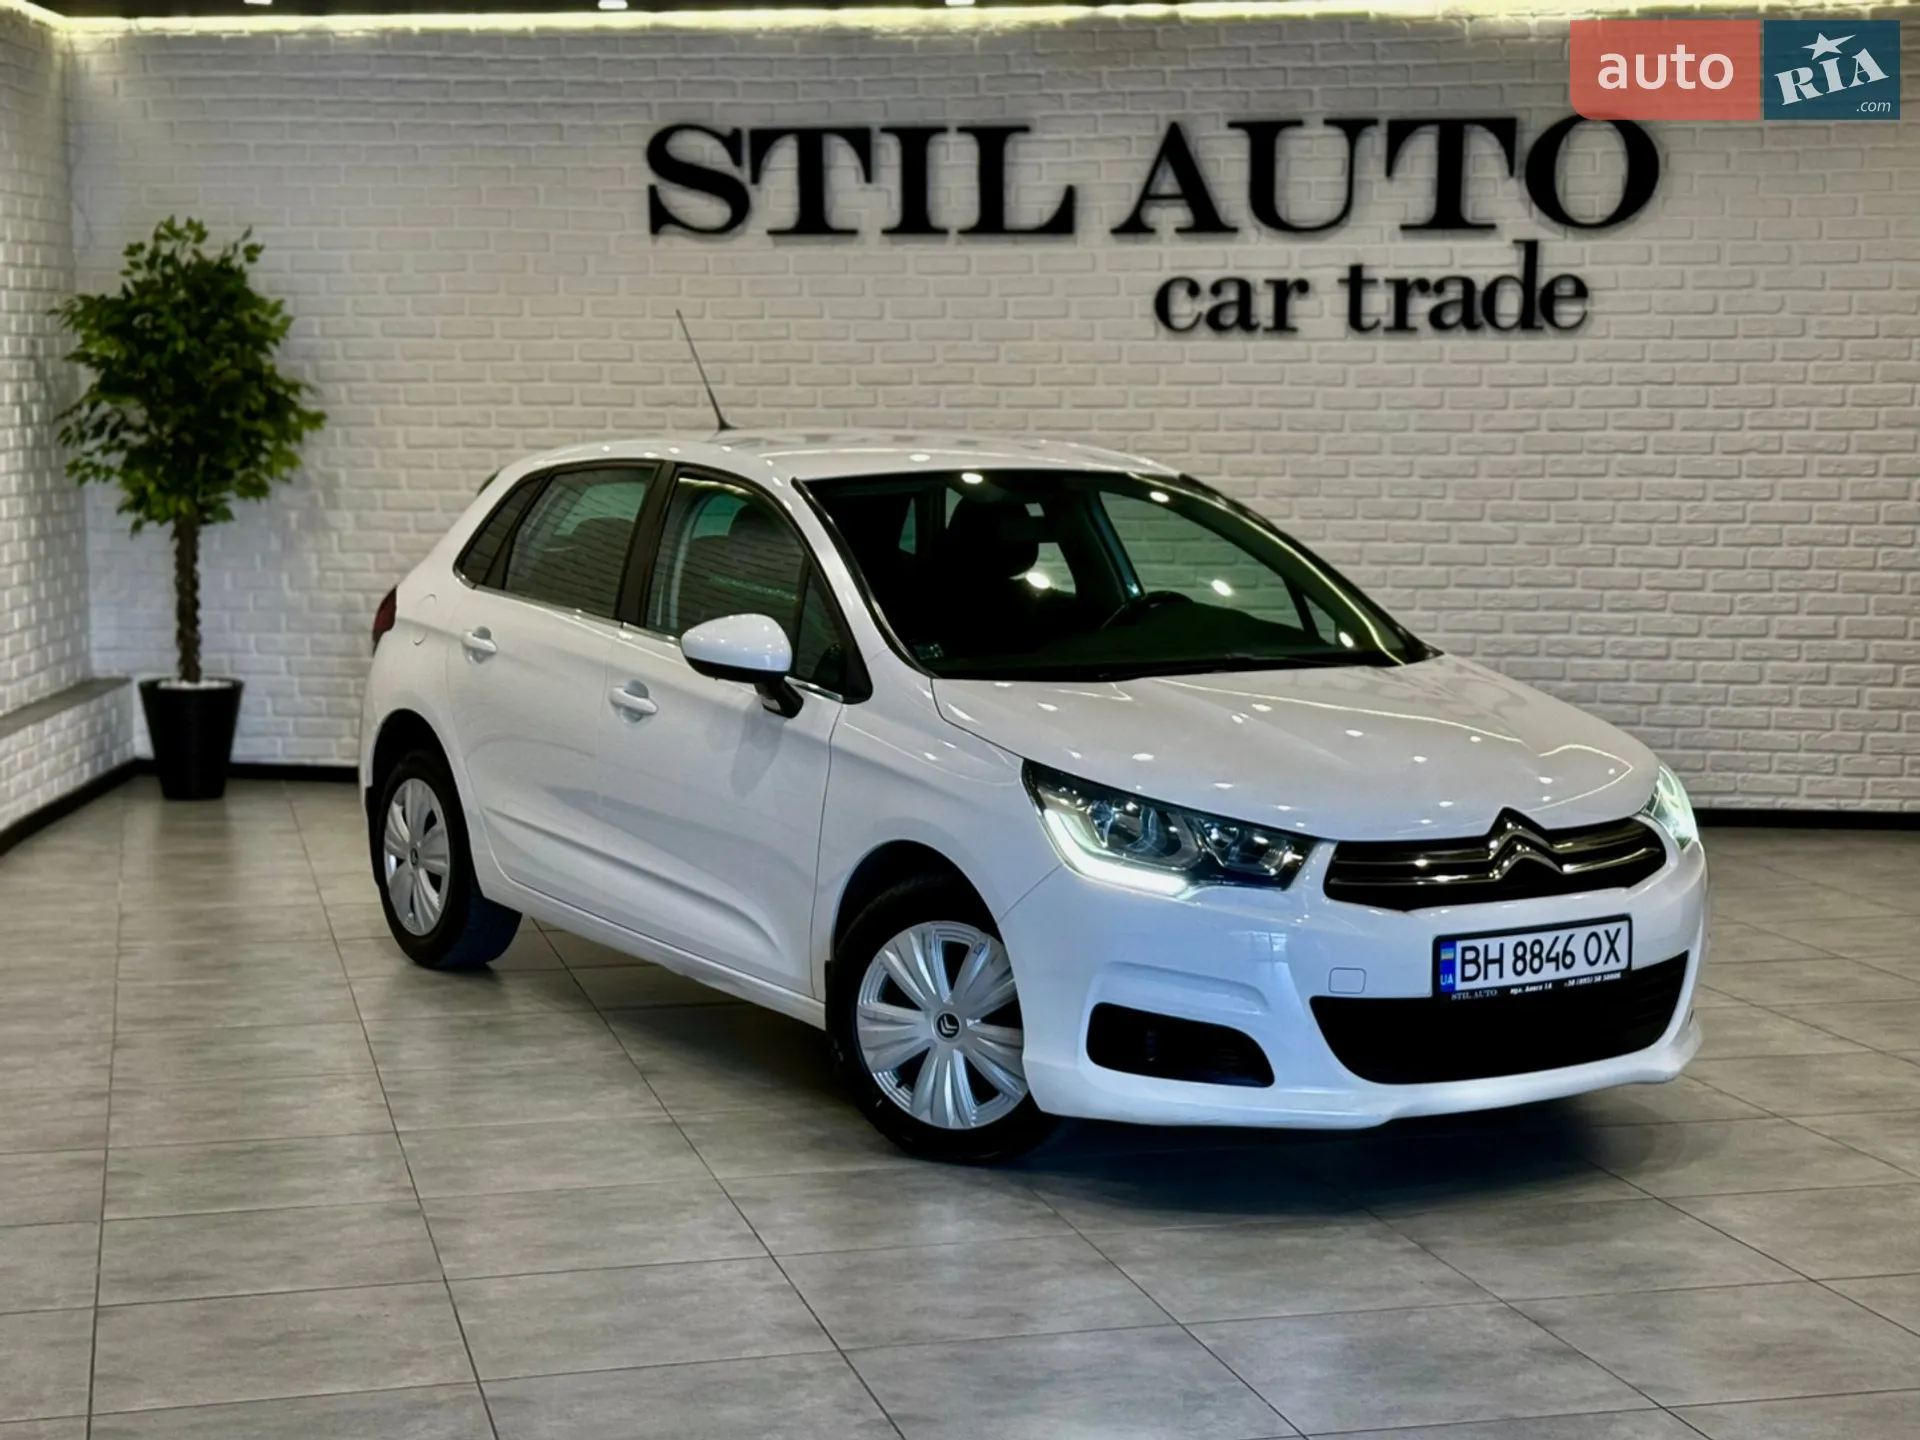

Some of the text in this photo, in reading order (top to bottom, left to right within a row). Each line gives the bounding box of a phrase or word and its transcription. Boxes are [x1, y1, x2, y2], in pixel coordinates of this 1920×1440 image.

[645, 112, 1661, 238] STIL AUTO
[1153, 239, 1589, 335] car trade
[1440, 973, 1454, 986] UA
[1460, 927, 1622, 983] BH 8846 OX
[1473, 988, 1498, 1000] AUTO
